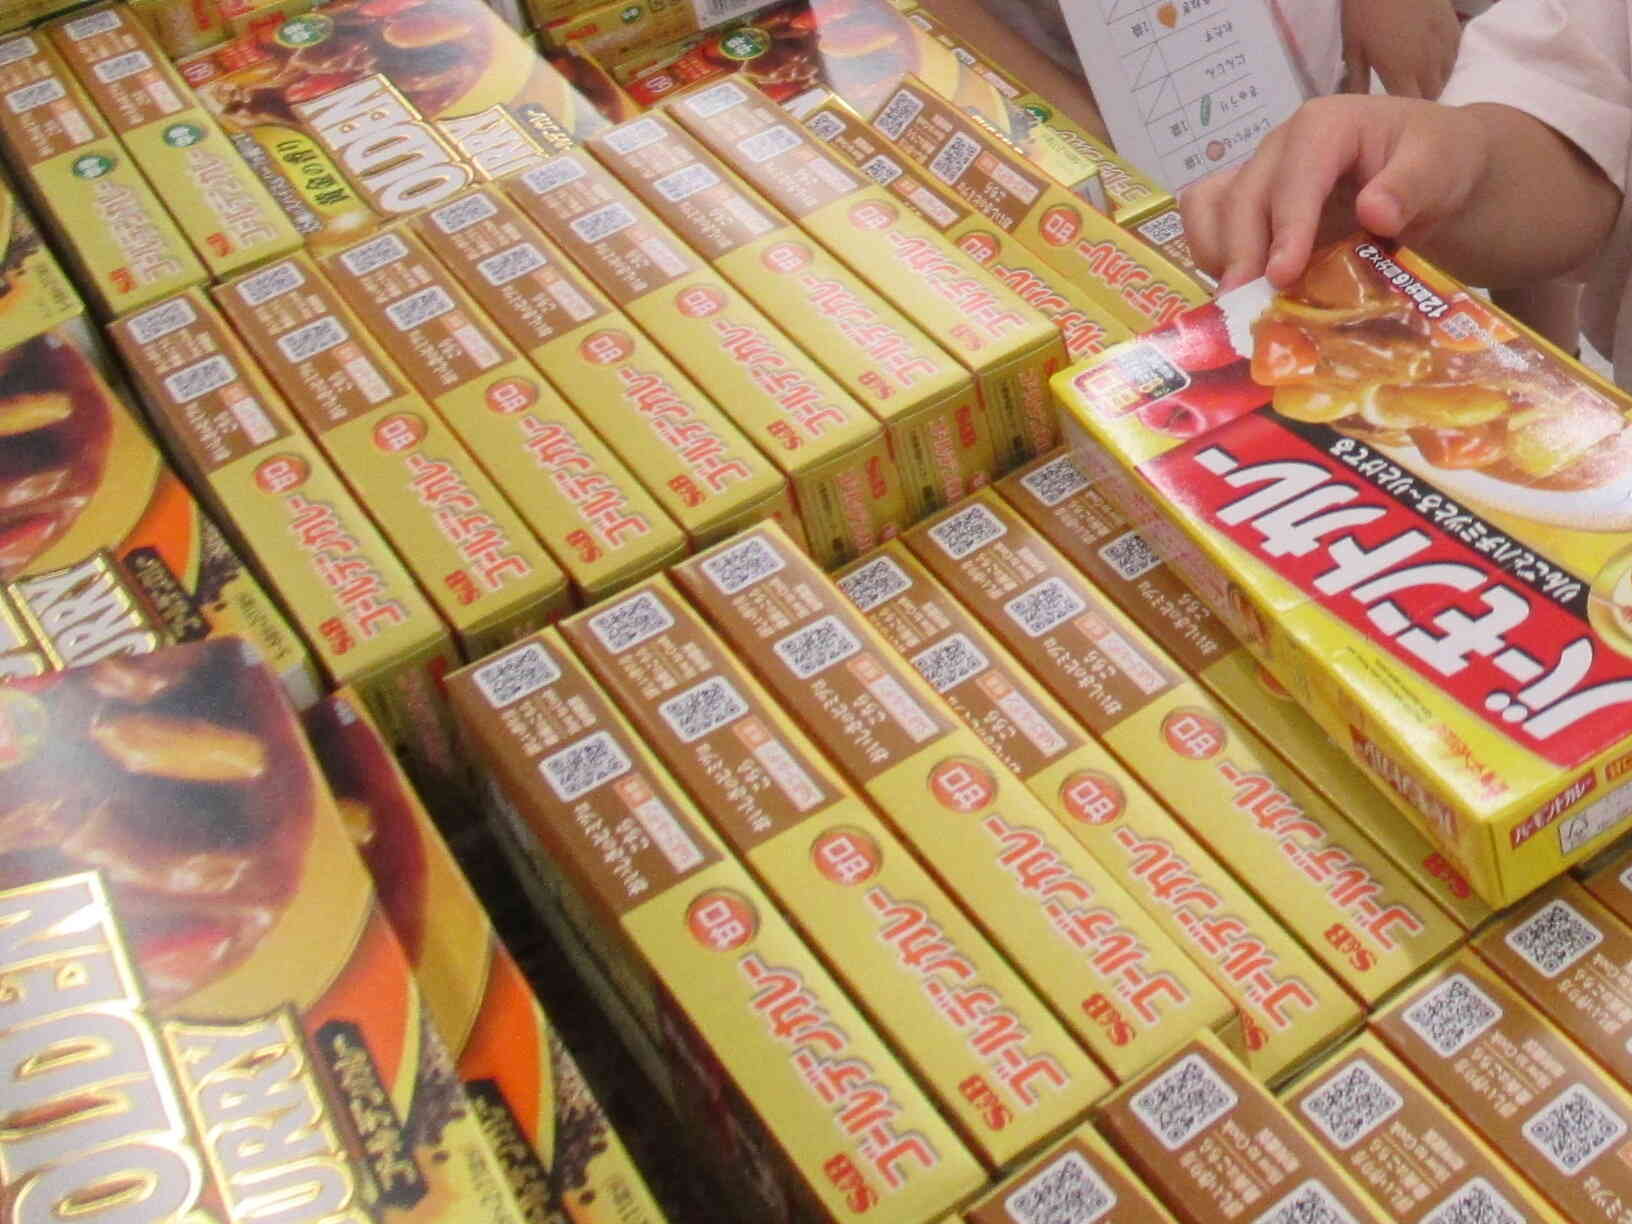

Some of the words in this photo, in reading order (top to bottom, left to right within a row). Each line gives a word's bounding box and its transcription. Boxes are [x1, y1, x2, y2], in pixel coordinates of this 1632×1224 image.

[276, 138, 357, 206] 黄金の香り
[294, 74, 473, 213] OLDEN
[1041, 212, 1078, 243] 甘口
[680, 290, 720, 317] 甘口
[884, 232, 1032, 340] ゴールデンカレー
[587, 336, 627, 364] 甘口
[797, 275, 944, 389] ゴールデンカレー
[489, 382, 530, 412] 甘口
[709, 319, 851, 439] ゴールデンカレー
[378, 420, 418, 451] 甘口
[615, 367, 753, 494] ゴールデンカレー
[765, 419, 808, 452] S&B
[261, 461, 299, 493] 甘口
[516, 415, 655, 552] ゴールデンカレー
[667, 472, 709, 507] S&B
[403, 454, 533, 595] ゴールデンカレー
[563, 528, 606, 566] S&B
[285, 496, 403, 641] ゴールデンカレー
[441, 570, 482, 606] S&B
[317, 616, 356, 655] S&B
[1170, 716, 1222, 758] 甘口
[936, 765, 990, 811] 甘口
[1068, 779, 1119, 819] 甘口
[819, 834, 873, 882] 甘口
[1215, 763, 1428, 954] ゴールデンカレー
[694, 899, 750, 950] 甘口
[980, 816, 1193, 1029] ゴールデンカレー
[1111, 826, 1321, 1023] ゴールデンカレー
[1323, 921, 1382, 973] S&B
[862, 888, 1070, 1112] ゴールデンカレー
[1078, 991, 1140, 1049] S&B
[736, 957, 943, 1196] ゴールデンカレー
[956, 1072, 1017, 1134] S&B
[164, 1014, 357, 1224] URRY
[820, 1152, 882, 1215] S&B
